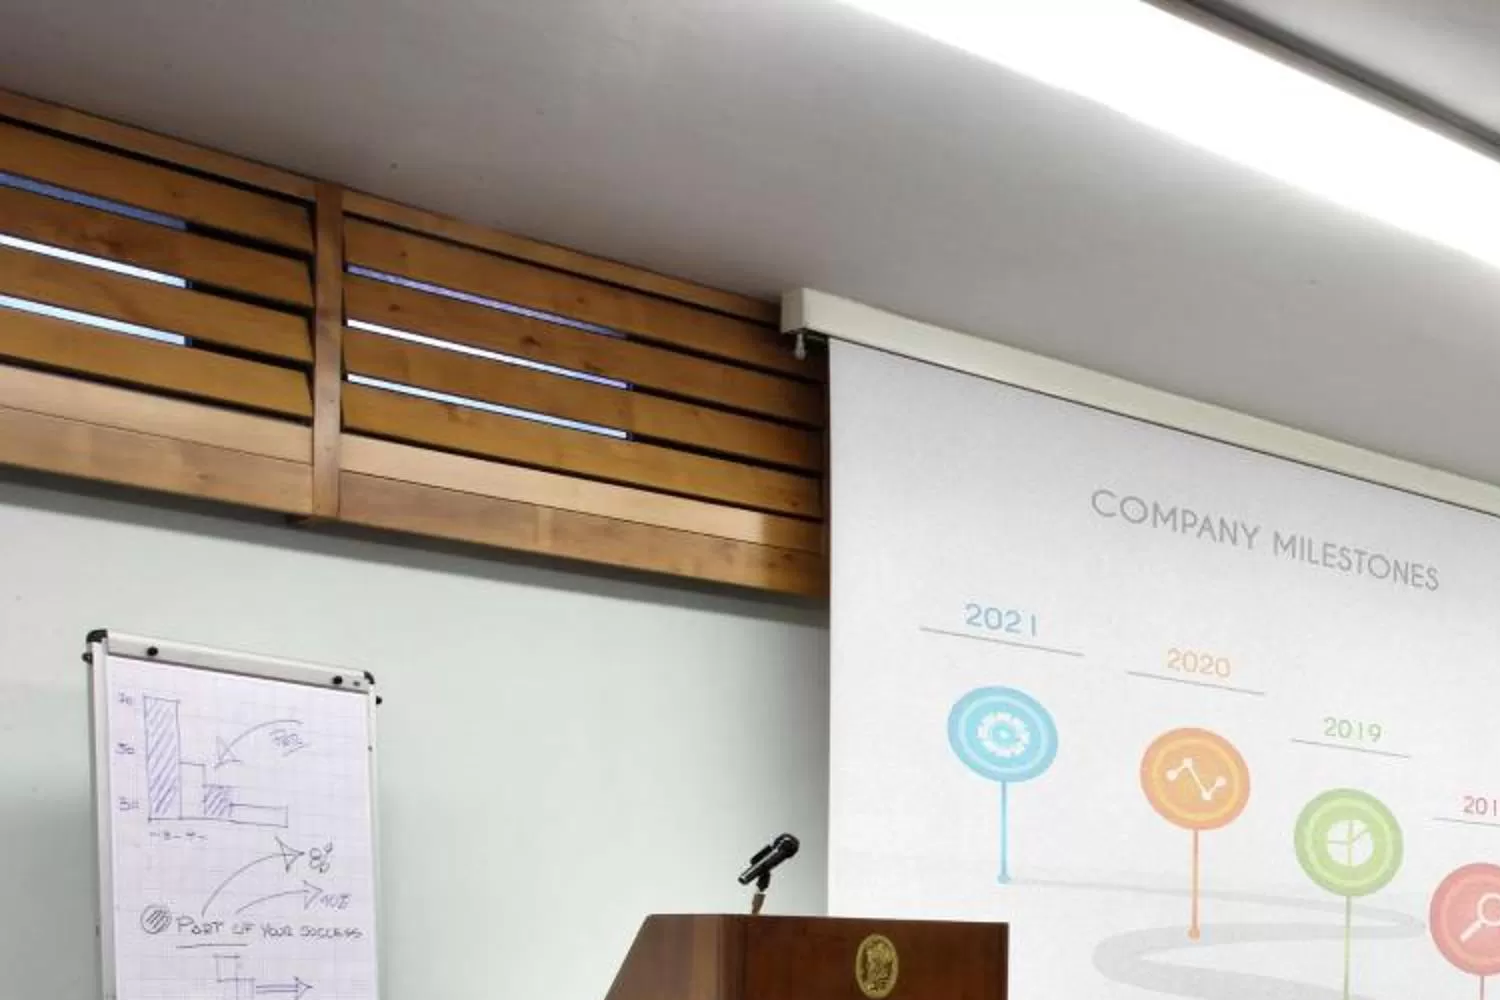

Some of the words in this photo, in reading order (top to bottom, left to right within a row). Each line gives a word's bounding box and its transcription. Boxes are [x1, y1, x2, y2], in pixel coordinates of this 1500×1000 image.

[1091, 488, 1262, 551] COMPANY
[1272, 530, 1440, 592] MILESTONES
[964, 602, 1038, 638] 2021
[1166, 647, 1232, 679] 2020
[1323, 716, 1383, 743] 2019
